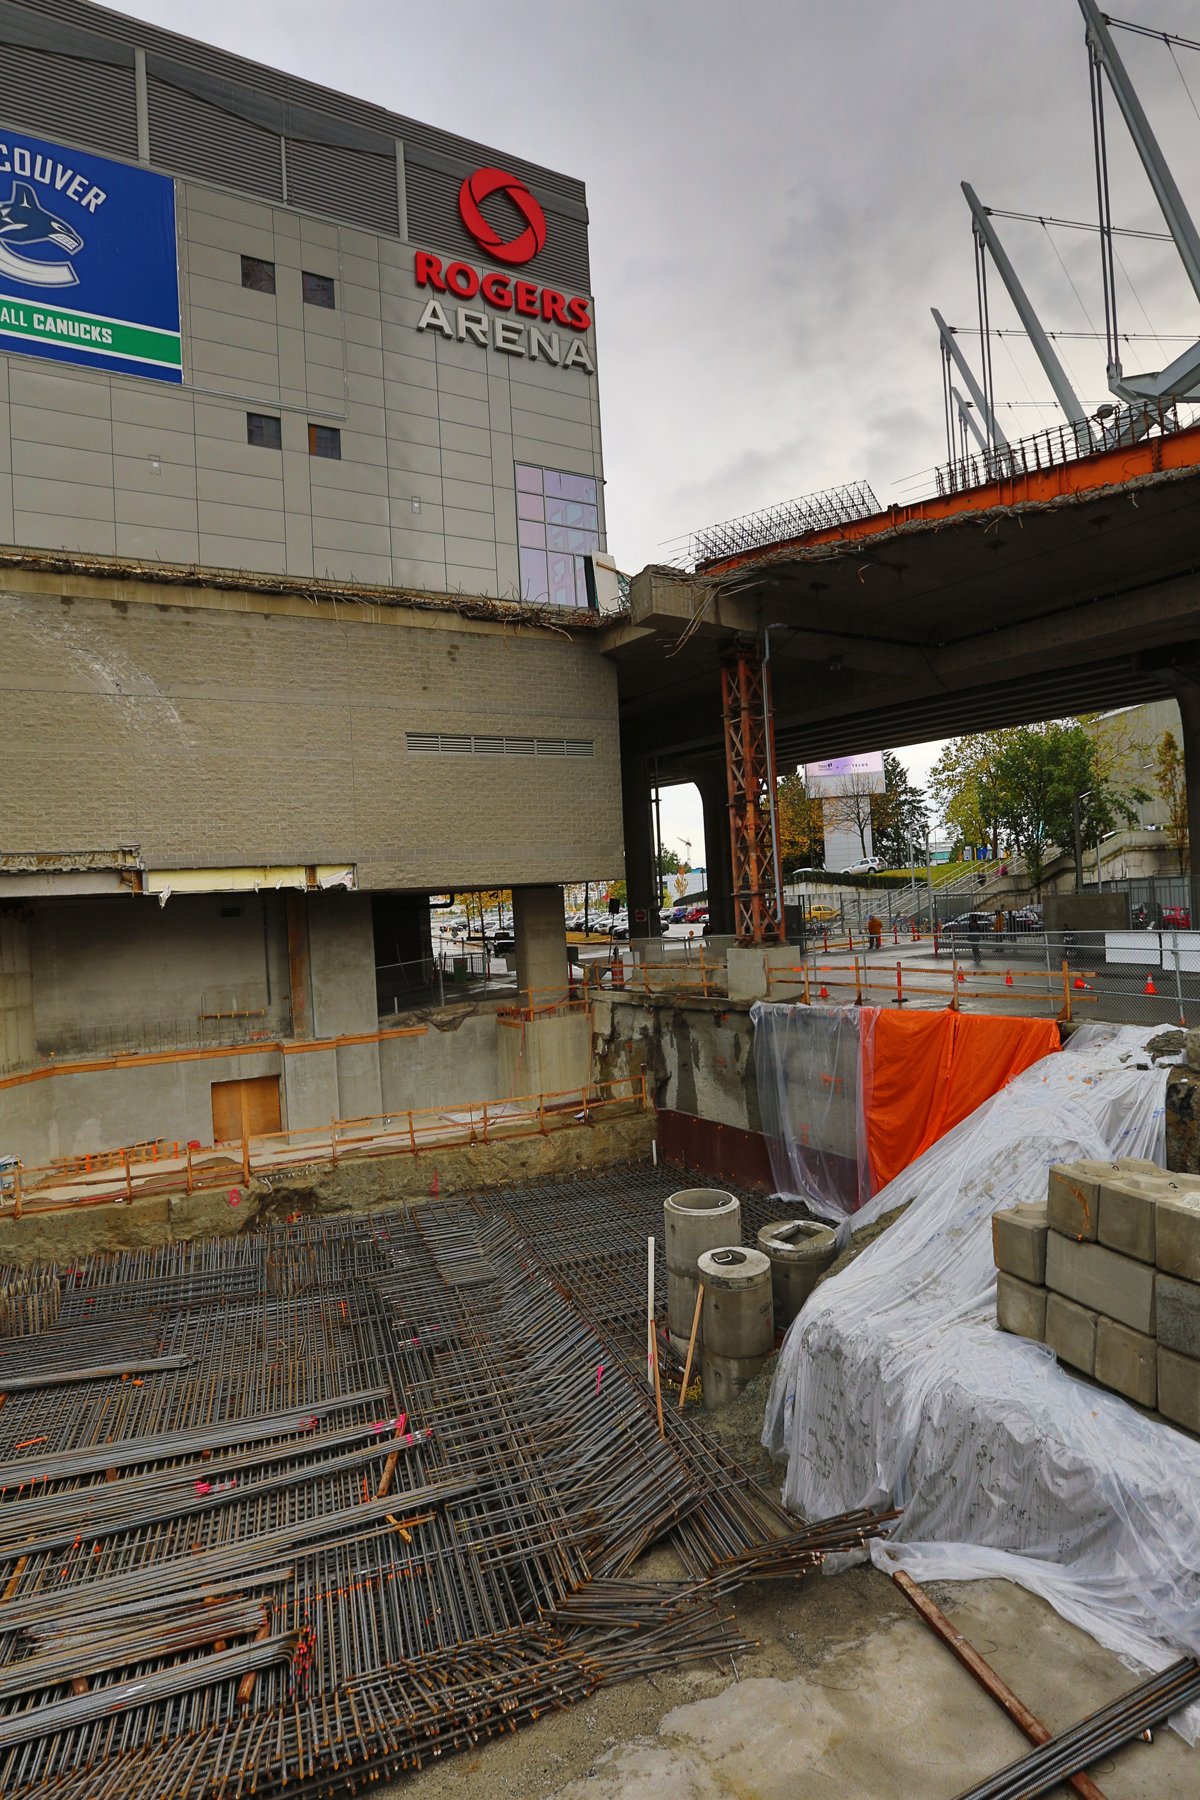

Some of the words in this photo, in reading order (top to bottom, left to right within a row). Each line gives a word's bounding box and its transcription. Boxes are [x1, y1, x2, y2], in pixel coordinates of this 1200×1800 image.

[1, 307, 28, 327] ALL
[34, 313, 112, 343] CANUCKS
[415, 251, 591, 331] ROGERS
[416, 300, 595, 374] ARENA
